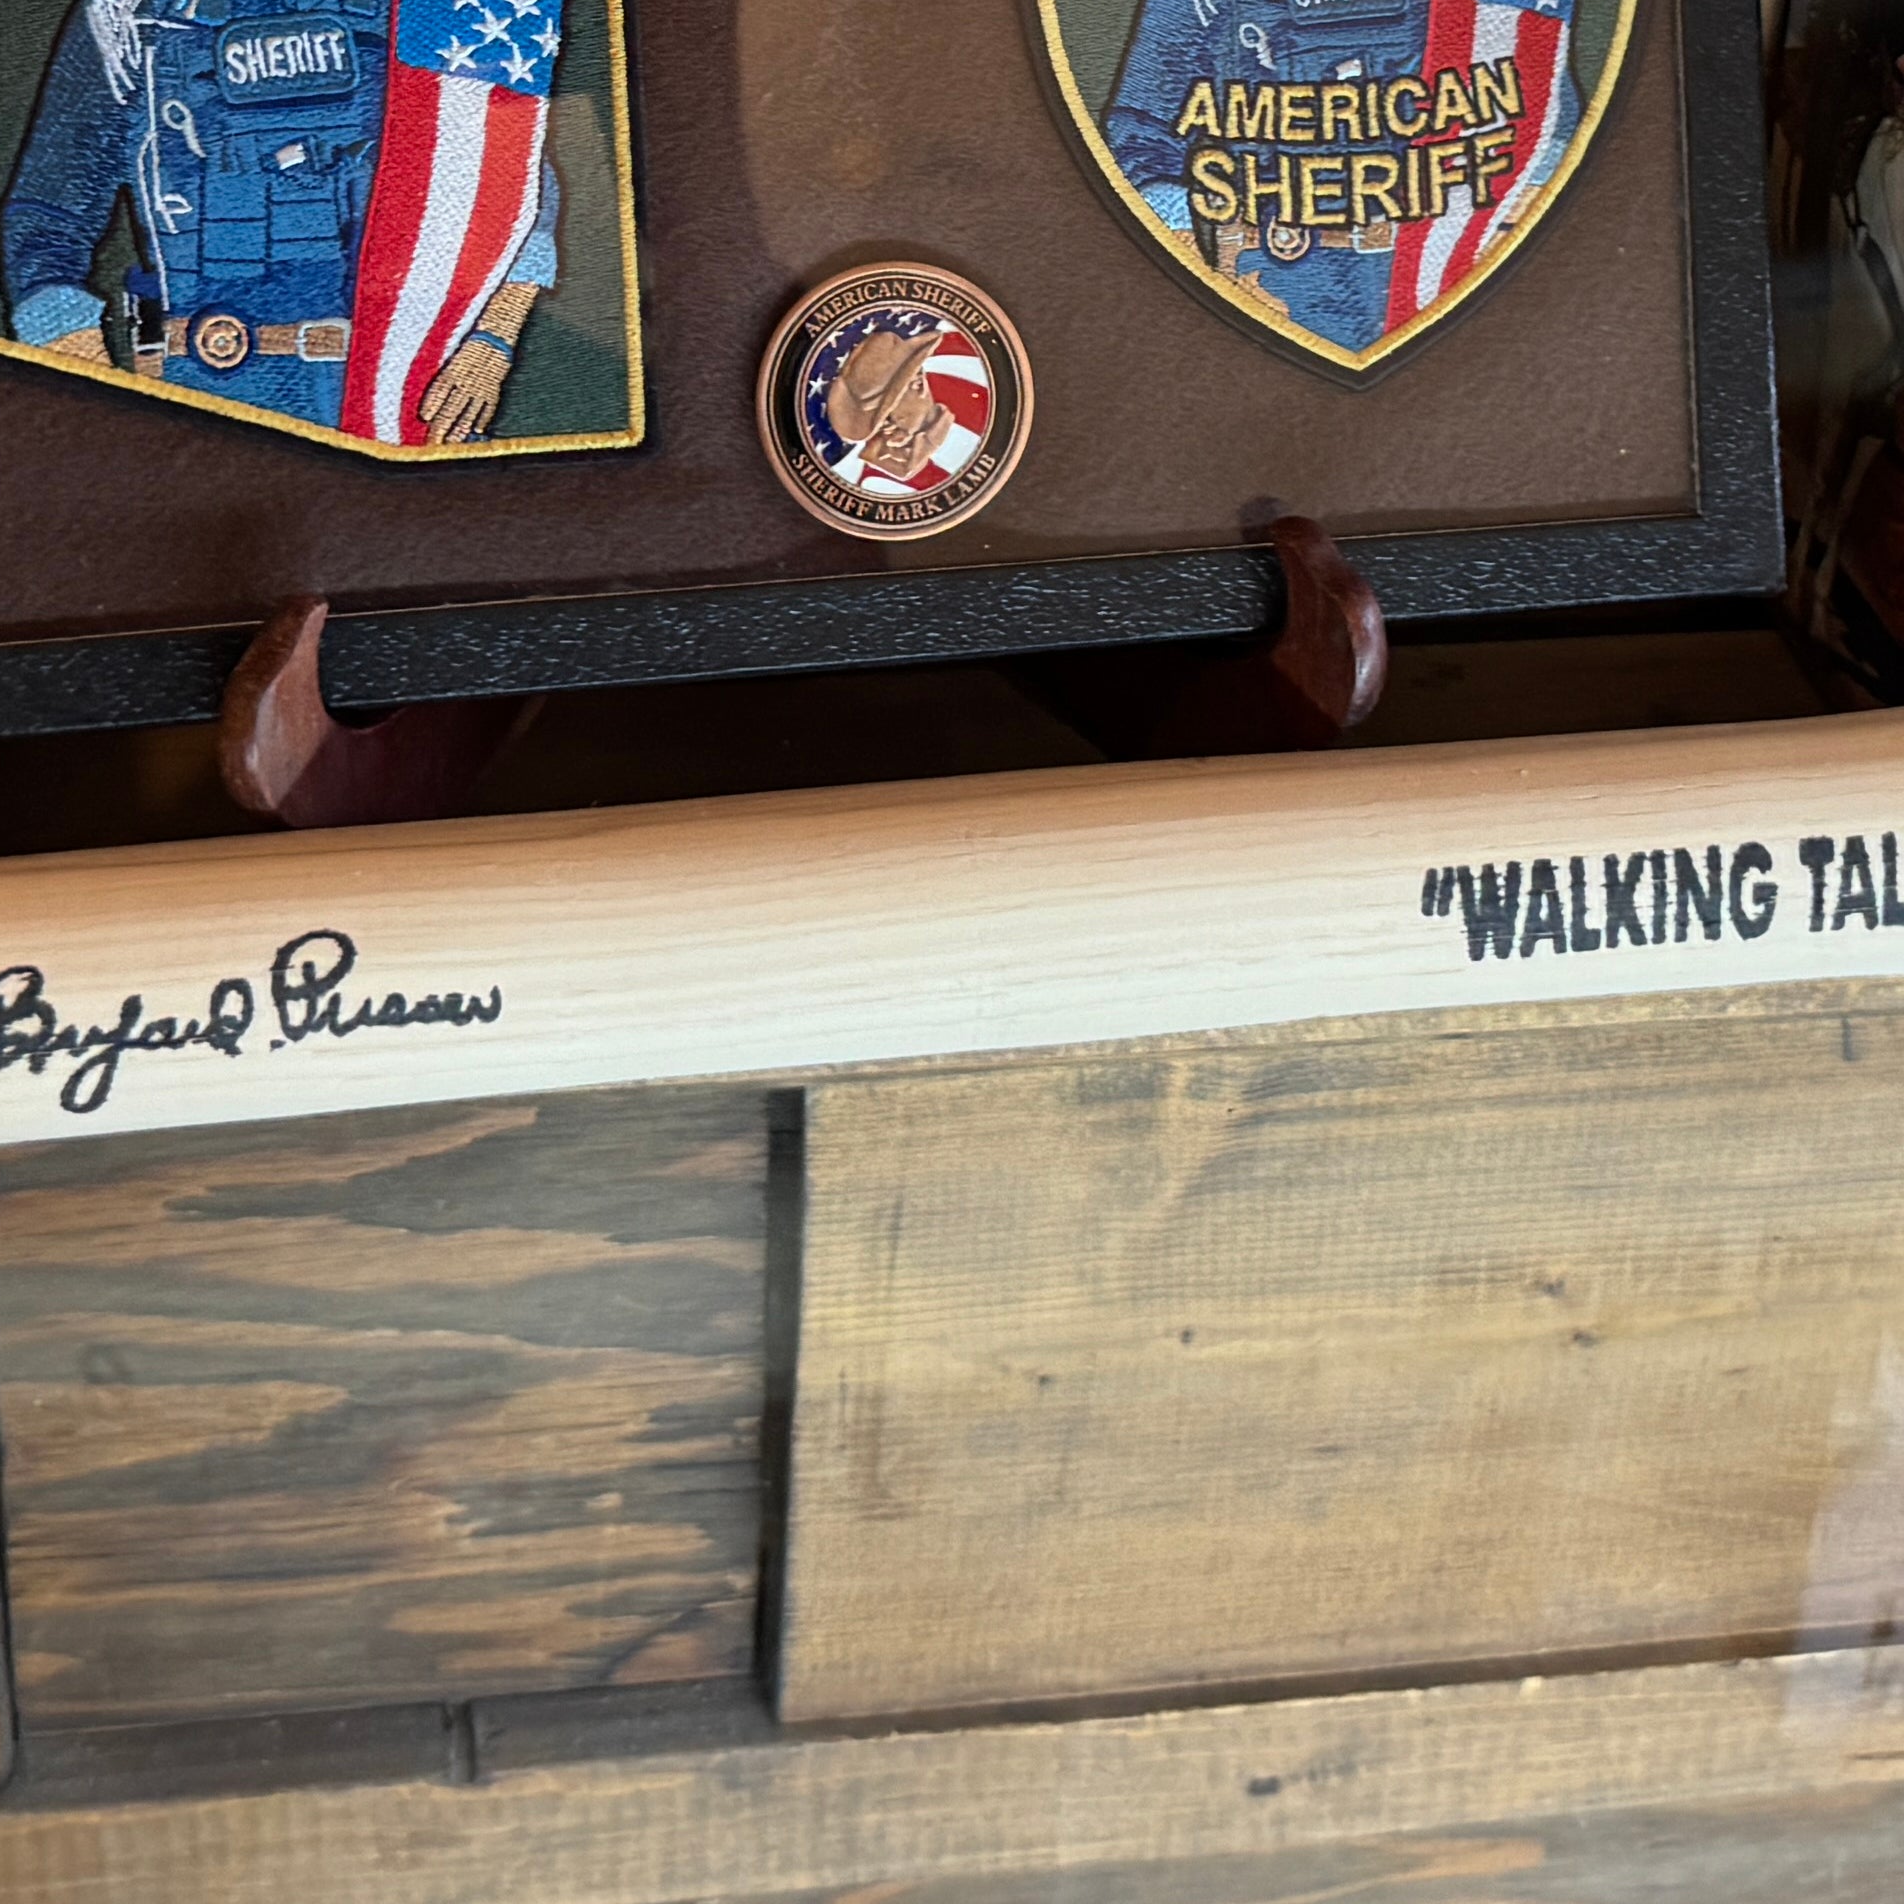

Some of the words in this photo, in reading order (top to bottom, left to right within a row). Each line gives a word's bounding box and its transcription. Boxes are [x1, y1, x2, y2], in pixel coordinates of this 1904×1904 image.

[224, 31, 346, 86] SHERIFF
[1176, 59, 1524, 140] AMERICAN
[1189, 134, 1515, 227] SHERIFF
[804, 281, 908, 337] AMERICAN
[912, 283, 991, 335] SHERIFF
[793, 453, 873, 516] SHERIFF
[876, 496, 943, 521] MARK
[948, 453, 996, 505] LAMB
[1421, 841, 1778, 961] "WALKING
